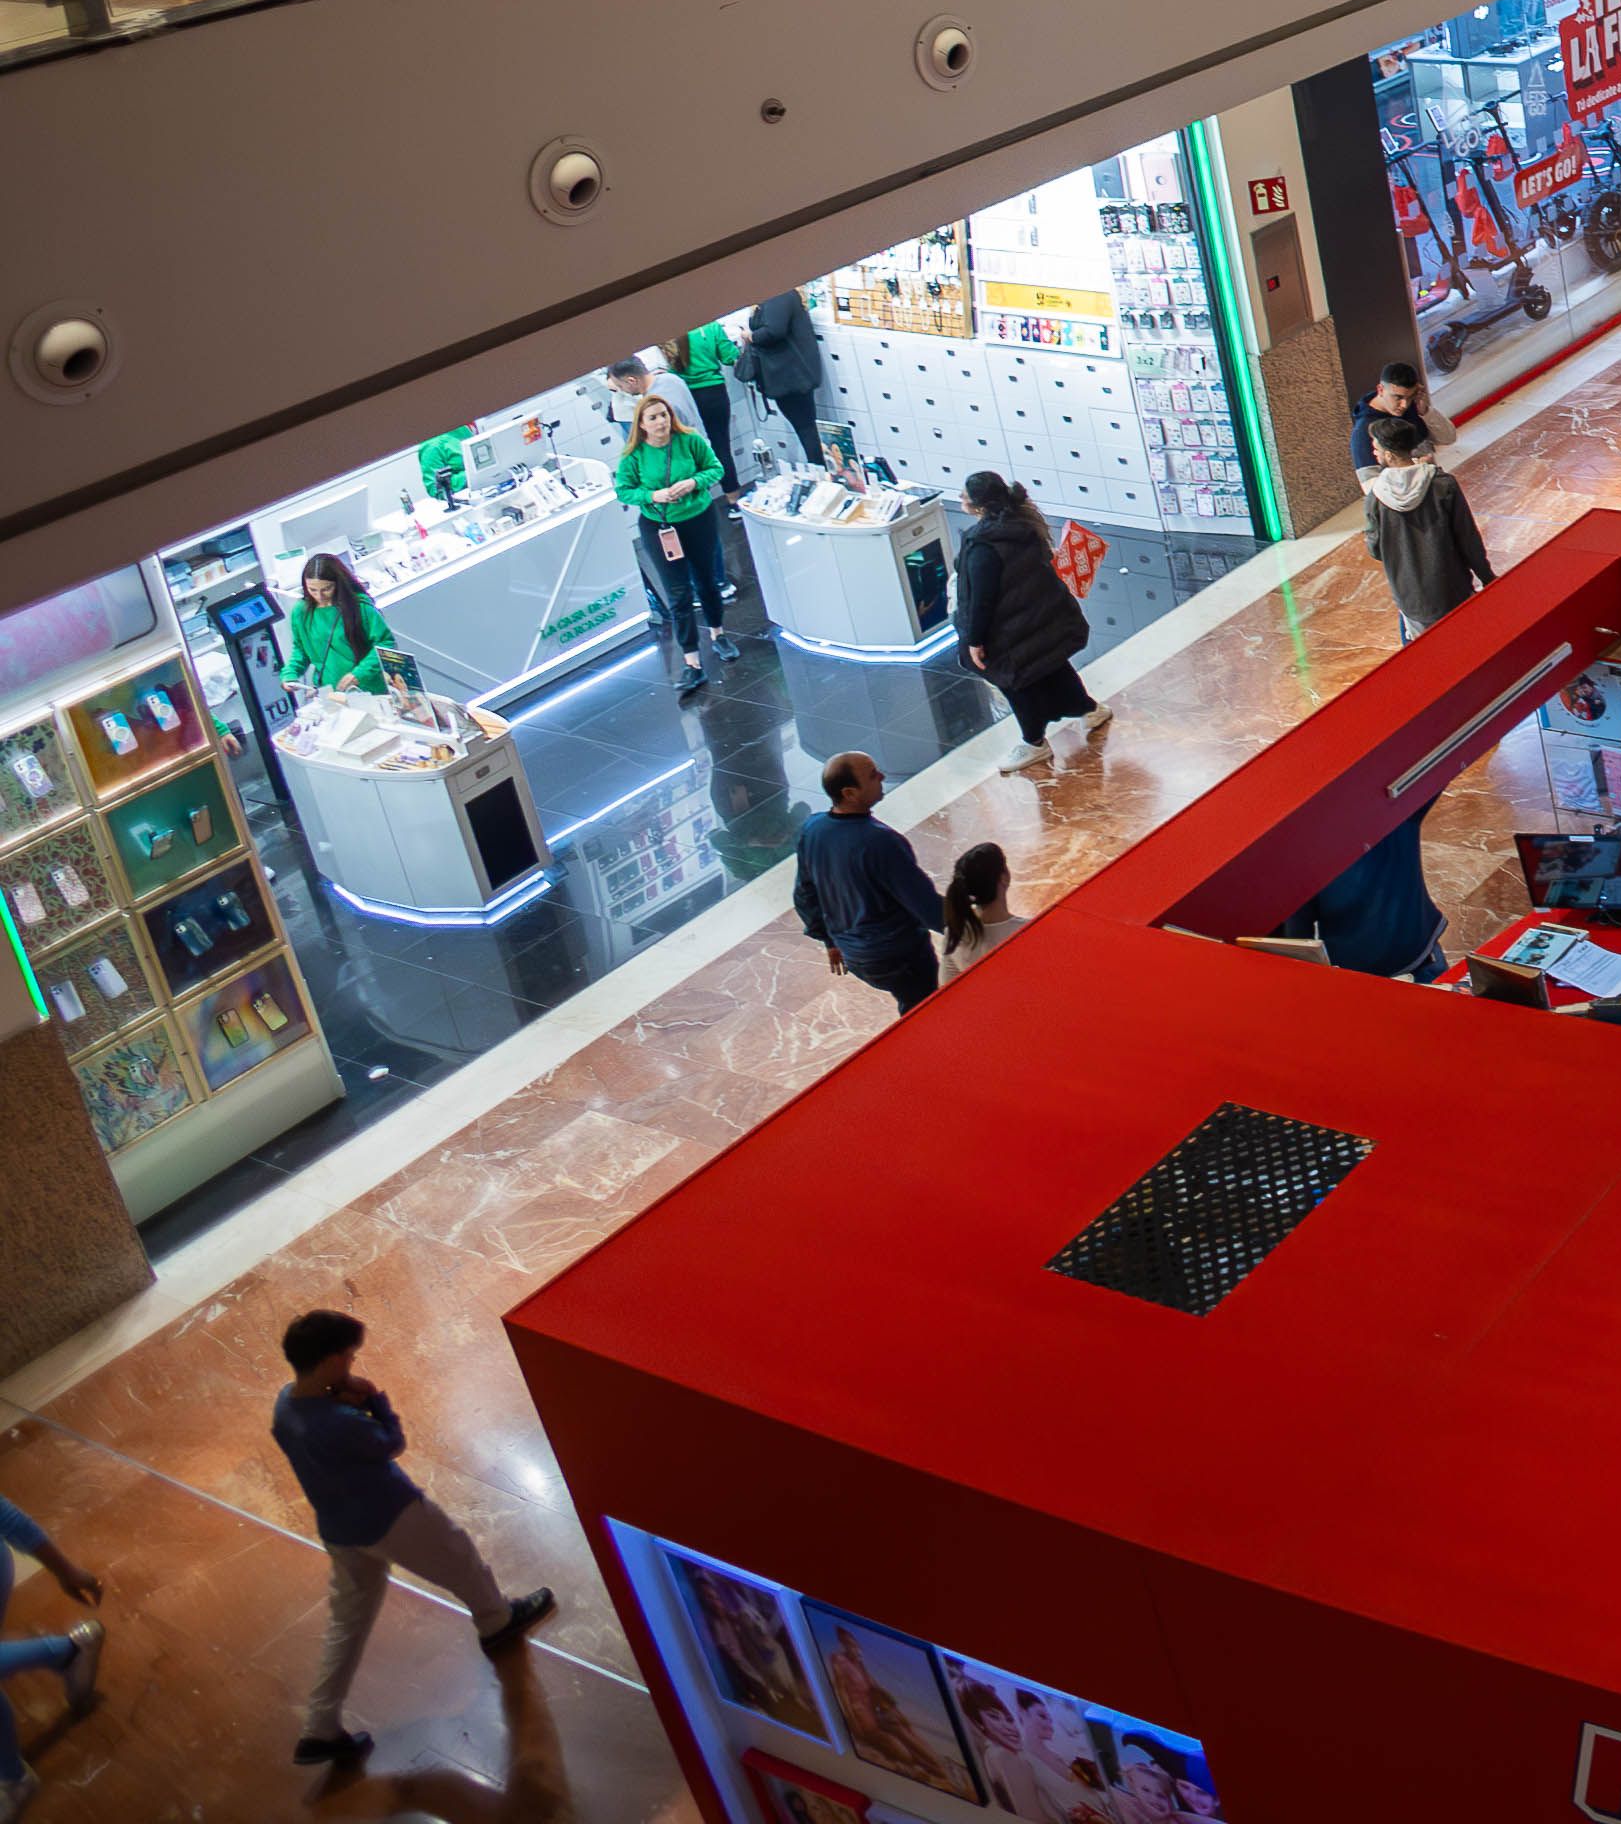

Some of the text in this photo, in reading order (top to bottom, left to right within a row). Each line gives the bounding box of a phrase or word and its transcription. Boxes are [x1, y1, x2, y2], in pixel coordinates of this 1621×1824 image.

[1570, 24, 1603, 83] LA
[1521, 155, 1578, 199] LET'S GO!
[557, 609, 586, 630] CASA
[560, 607, 617, 644] CARCASAS
